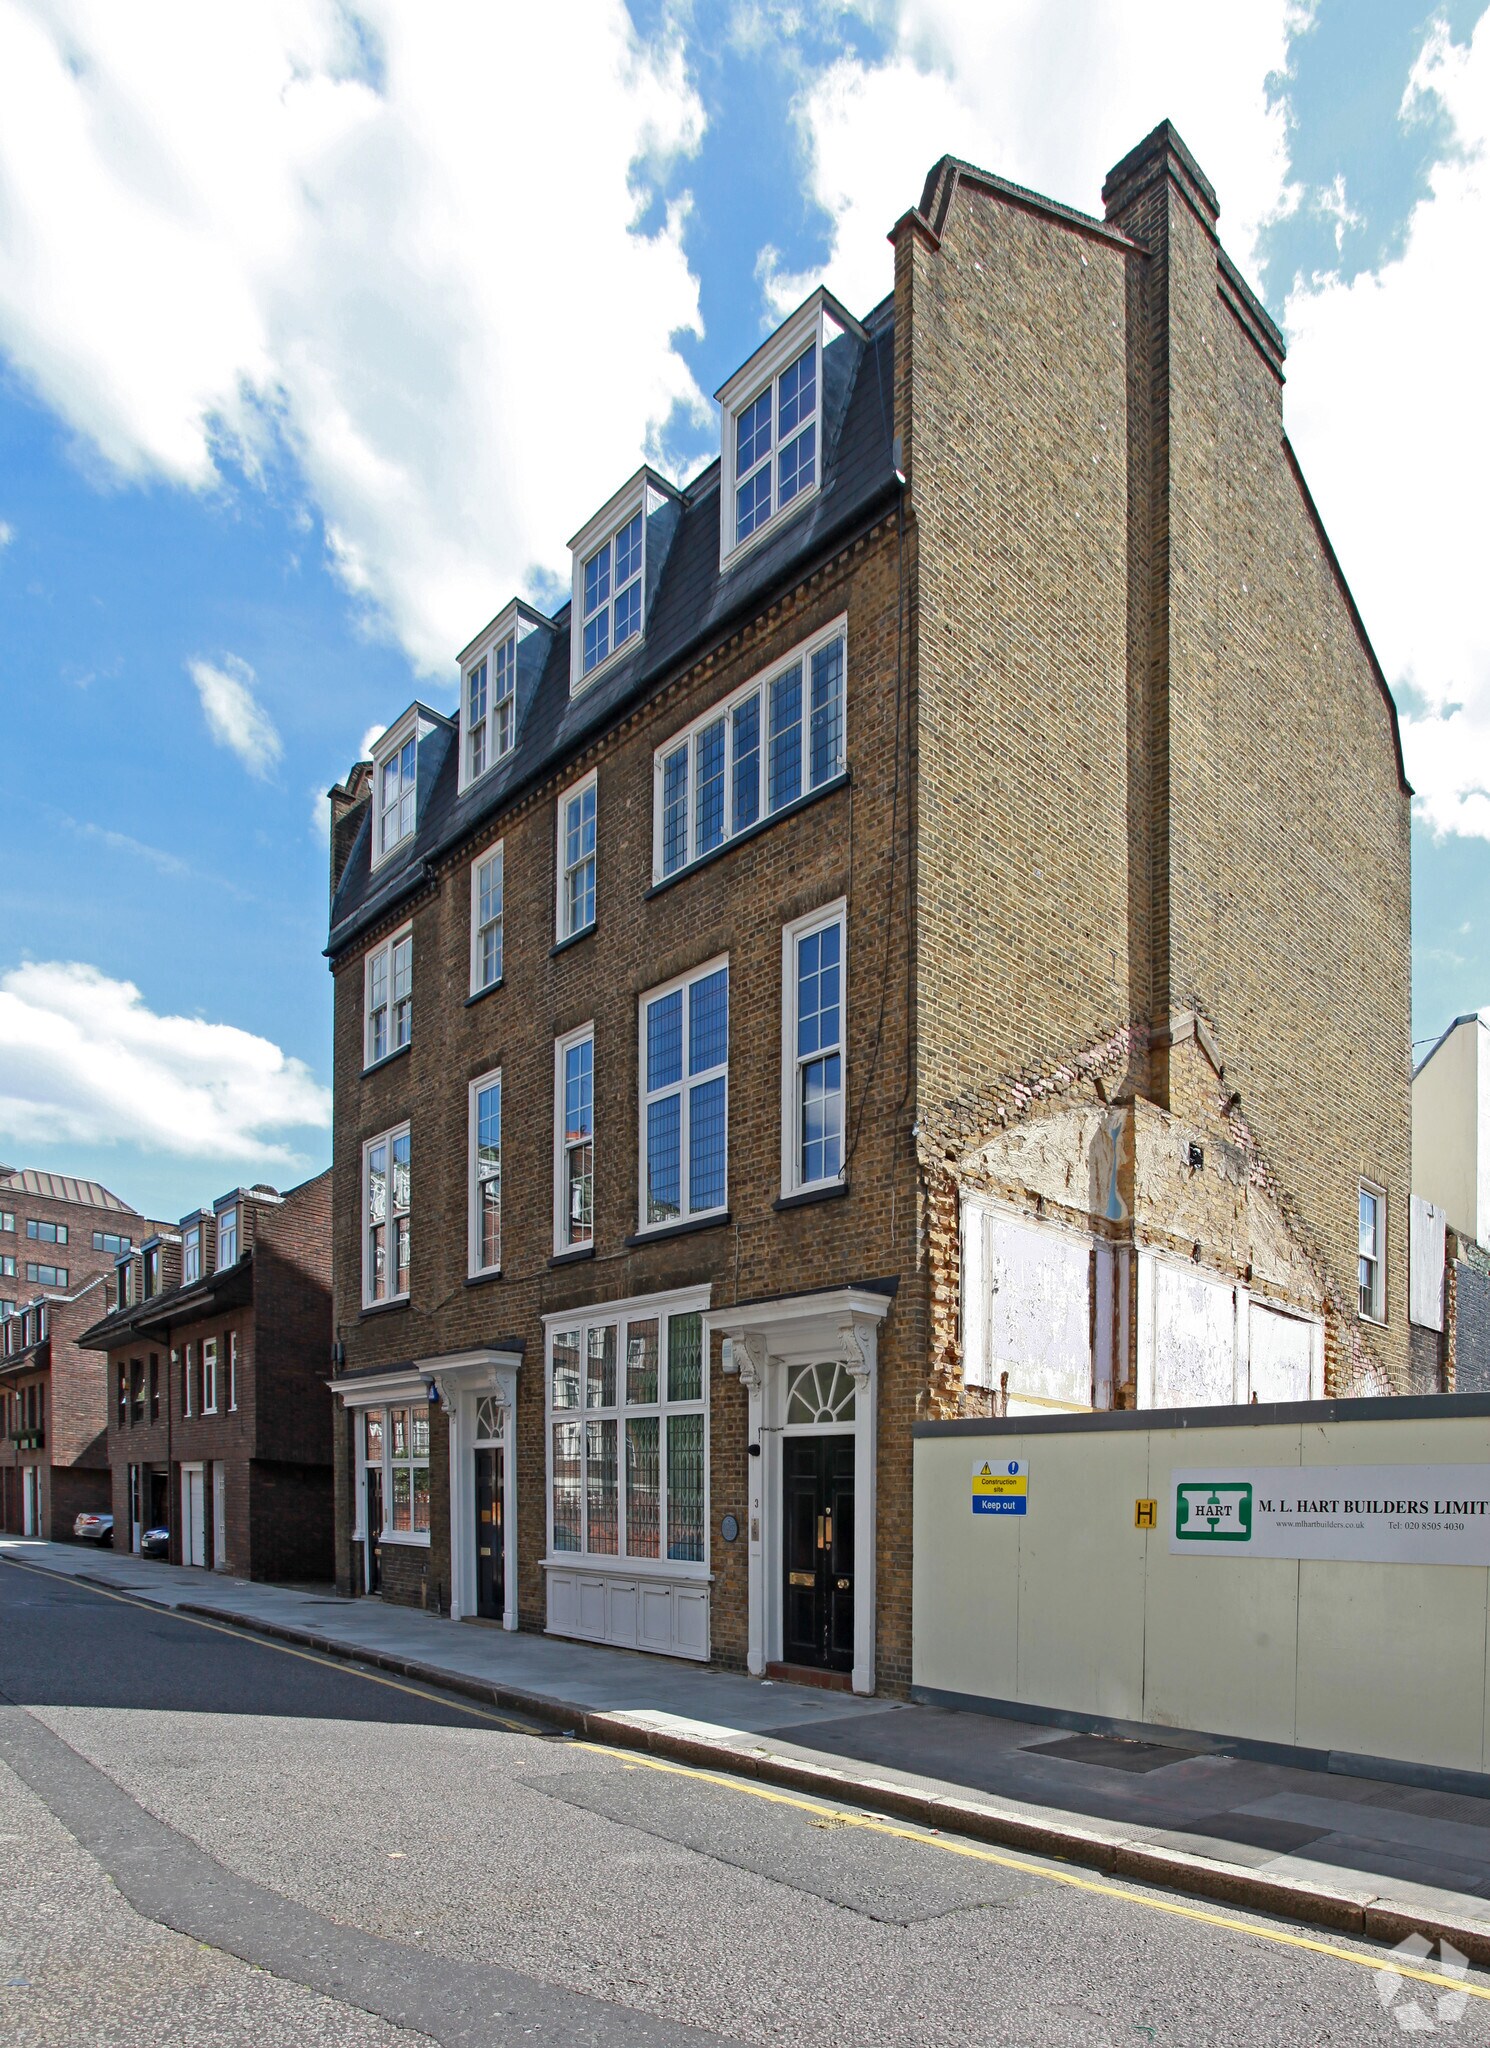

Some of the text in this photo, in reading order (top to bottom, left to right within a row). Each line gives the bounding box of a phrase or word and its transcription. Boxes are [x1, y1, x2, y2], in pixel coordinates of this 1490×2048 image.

[754, 1498, 759, 1509] 3
[981, 1500, 1016, 1511] Keep out
[1258, 1500, 1490, 1515] M. L. HART BUILDERS LIMIT
[1137, 1502, 1153, 1525] H
[1195, 1505, 1232, 1516] HART
[1275, 1520, 1365, 1529] www.mlhartbuilders.co.uk
[1388, 1521, 1465, 1531] Tel: 020 8505 4030
